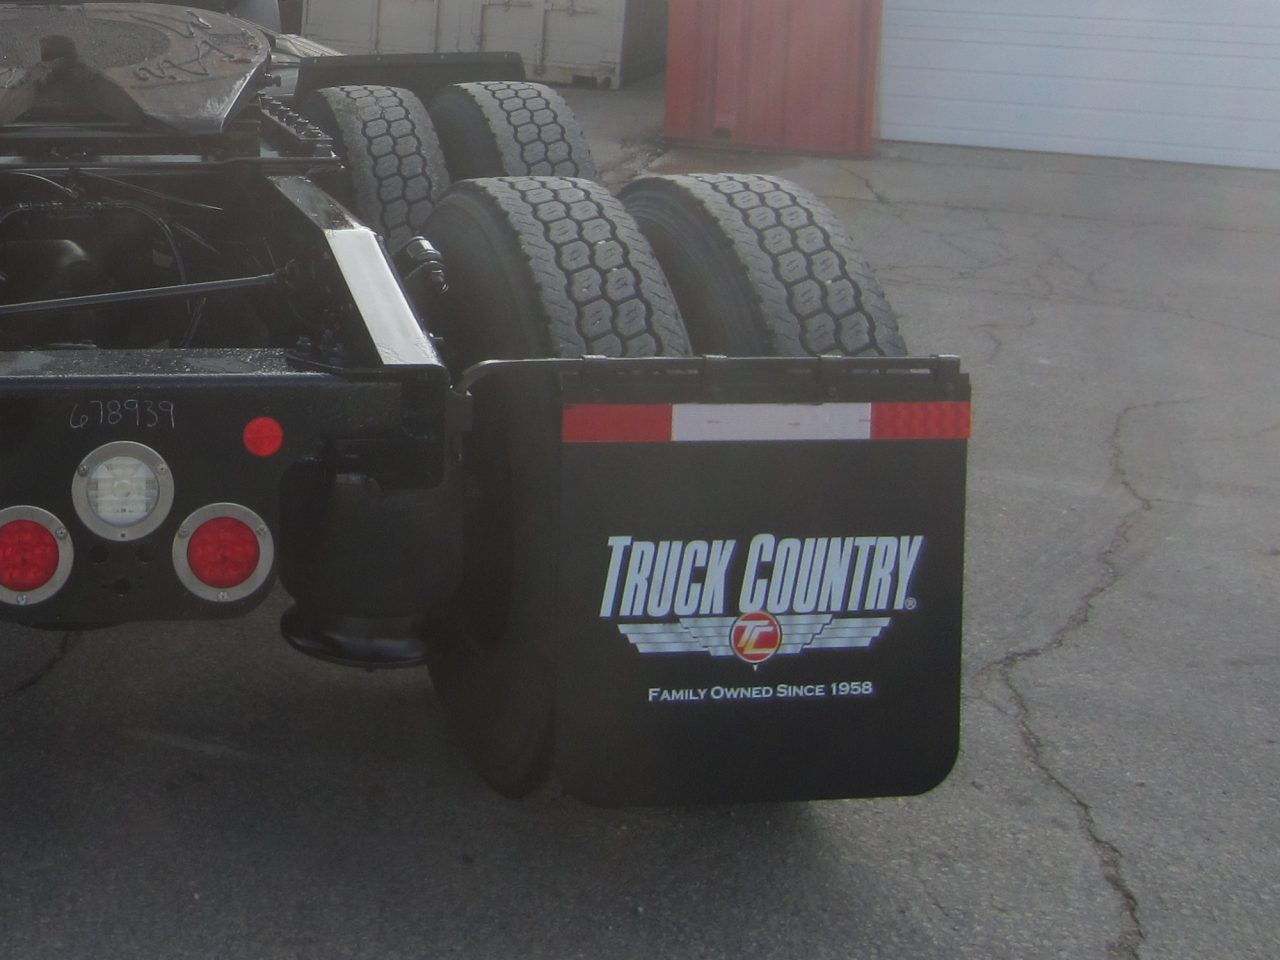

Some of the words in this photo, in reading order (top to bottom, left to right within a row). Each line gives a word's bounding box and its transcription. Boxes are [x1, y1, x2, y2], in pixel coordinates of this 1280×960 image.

[69, 399, 175, 428] 678939
[599, 535, 737, 618] TRUCK
[739, 533, 924, 616] COUNTRY
[648, 687, 707, 702] FAMILY
[710, 685, 774, 700] OWNED
[776, 683, 825, 697] SINCE
[831, 681, 873, 696] 1958
